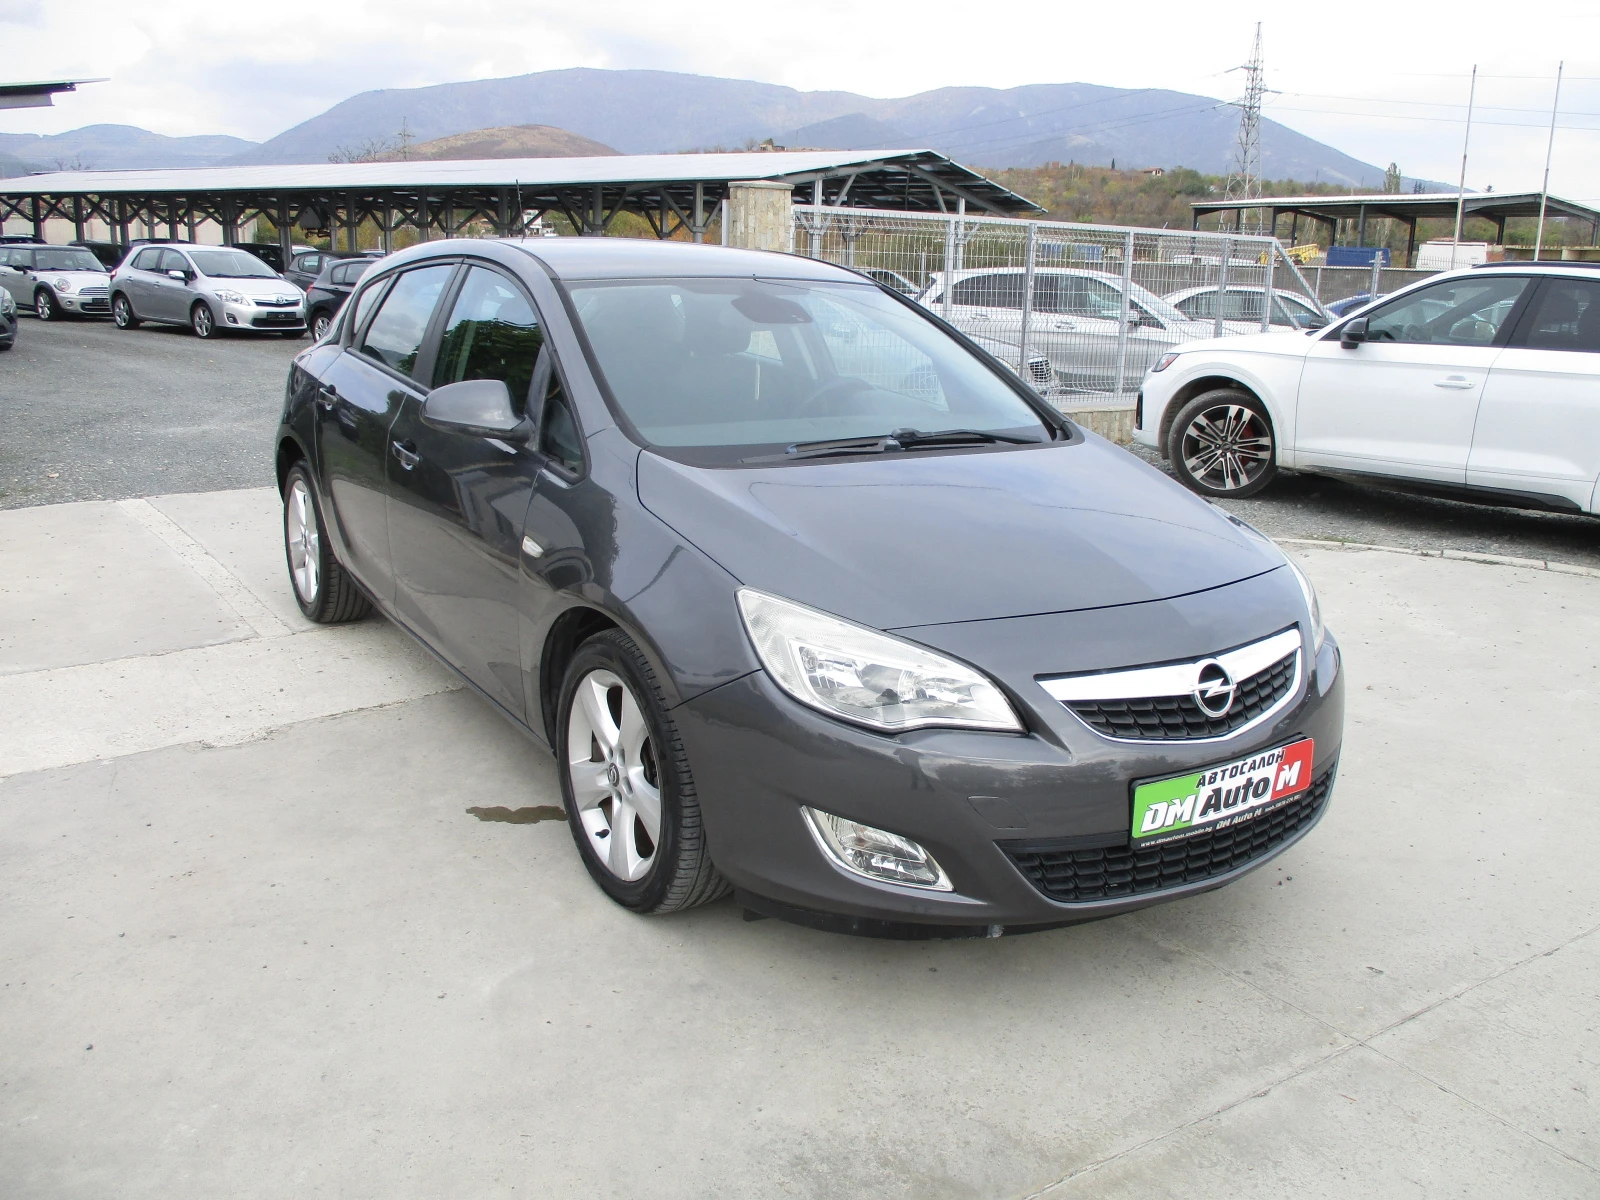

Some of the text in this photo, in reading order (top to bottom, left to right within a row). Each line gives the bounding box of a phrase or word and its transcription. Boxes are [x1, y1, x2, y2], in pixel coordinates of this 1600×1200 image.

[1140, 794, 1197, 833] DM
[1199, 776, 1271, 819] Auto
[1275, 760, 1302, 792] M
[1196, 749, 1285, 788] АВТОСАЛОН
